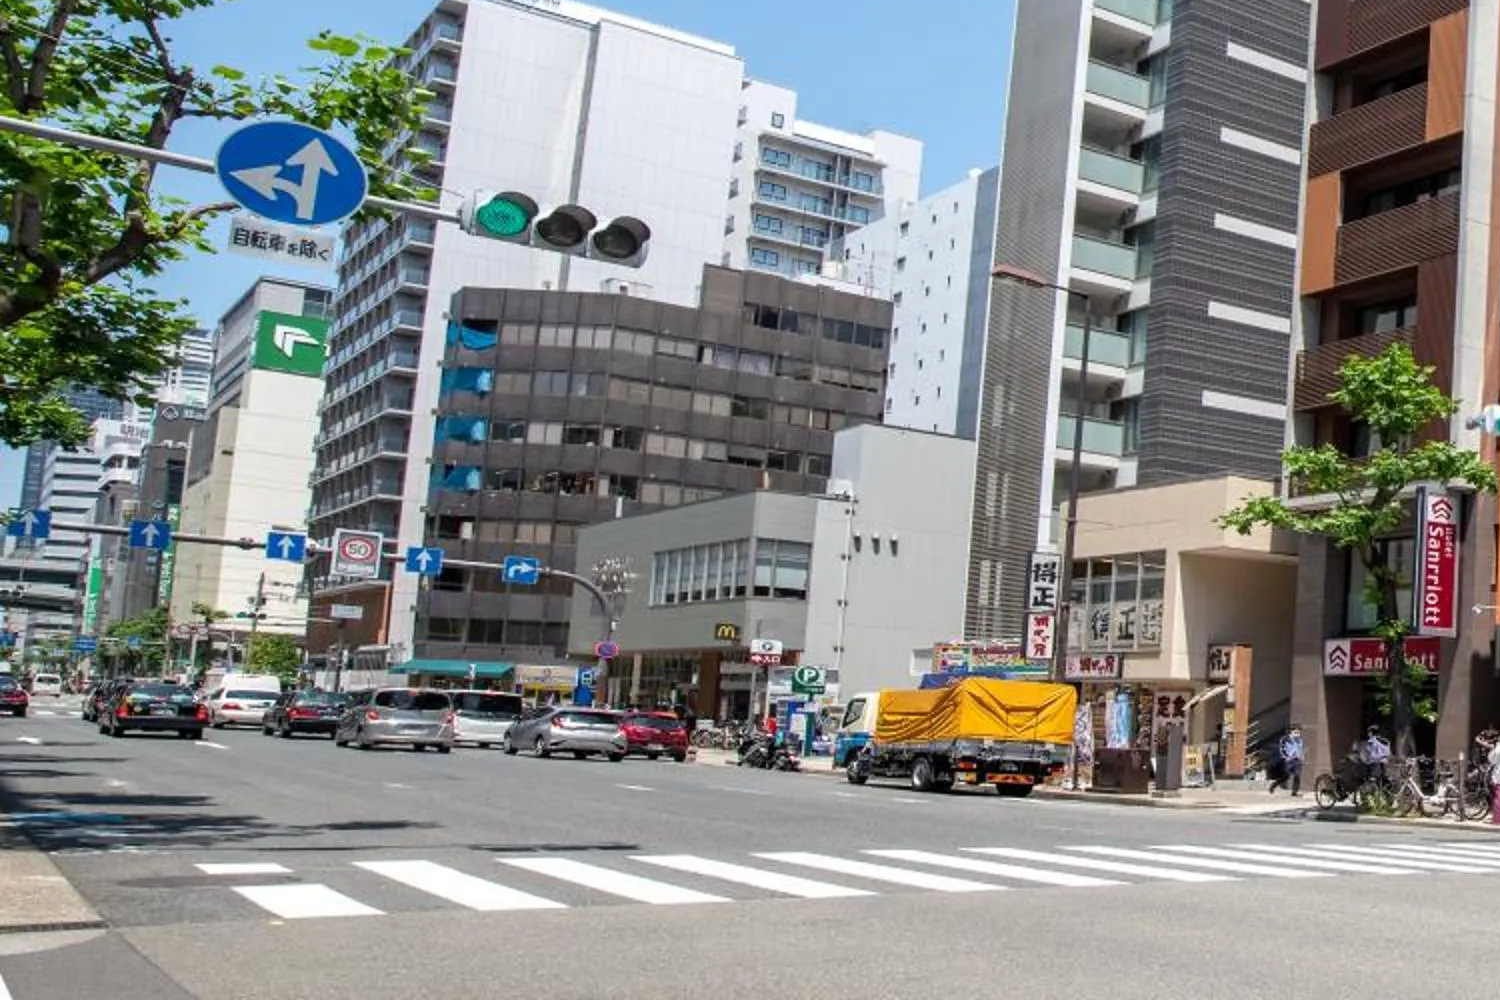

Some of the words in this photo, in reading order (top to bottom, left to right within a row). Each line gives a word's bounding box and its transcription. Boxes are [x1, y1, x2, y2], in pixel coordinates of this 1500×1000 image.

[232, 227, 329, 260] 自転車を除く
[349, 544, 368, 555] 50
[1031, 561, 1057, 608] 得正
[1426, 526, 1445, 624] Sanrriott
[803, 671, 817, 684] P
